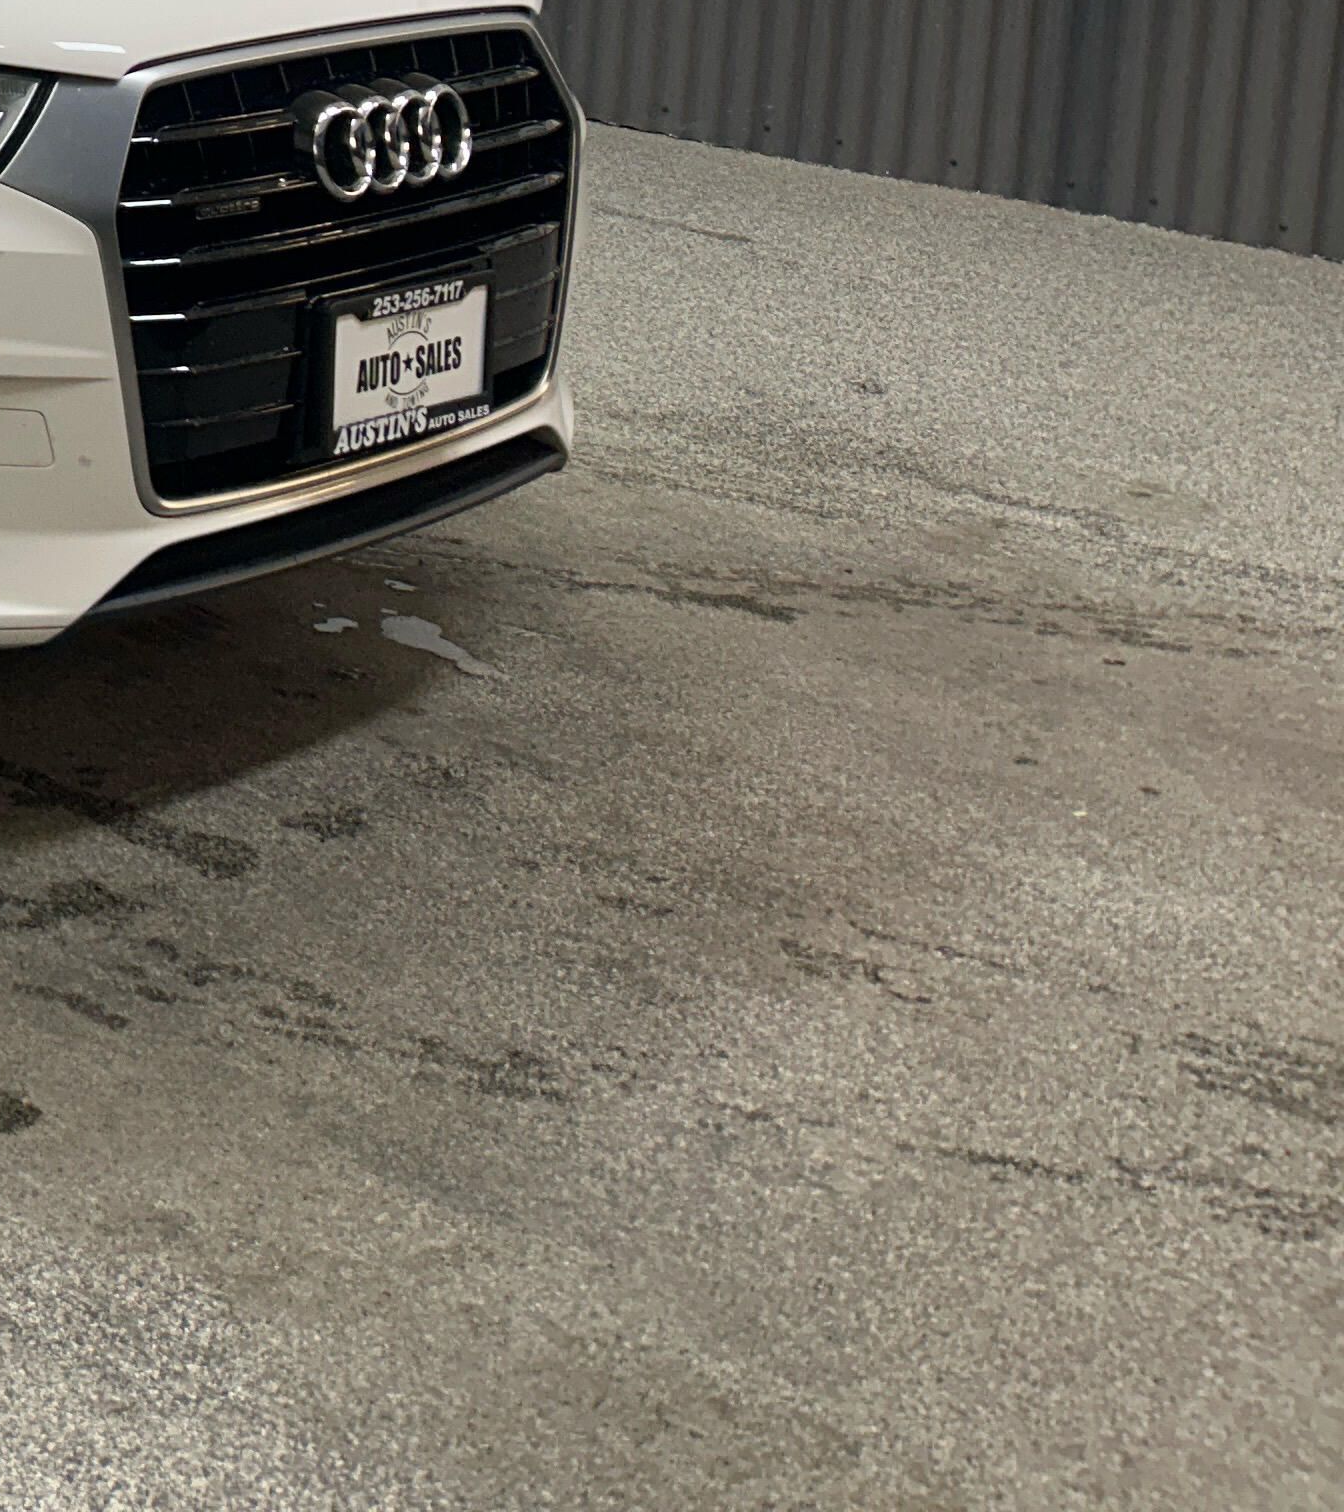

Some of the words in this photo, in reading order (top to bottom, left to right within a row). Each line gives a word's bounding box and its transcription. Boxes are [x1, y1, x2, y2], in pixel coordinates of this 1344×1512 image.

[372, 280, 464, 317] 253-256-7117
[356, 350, 401, 394] AUTO
[415, 336, 462, 379] SALES
[333, 406, 428, 455] AUSTIN'S
[428, 413, 455, 430] AUTO
[457, 404, 490, 422] SALES
